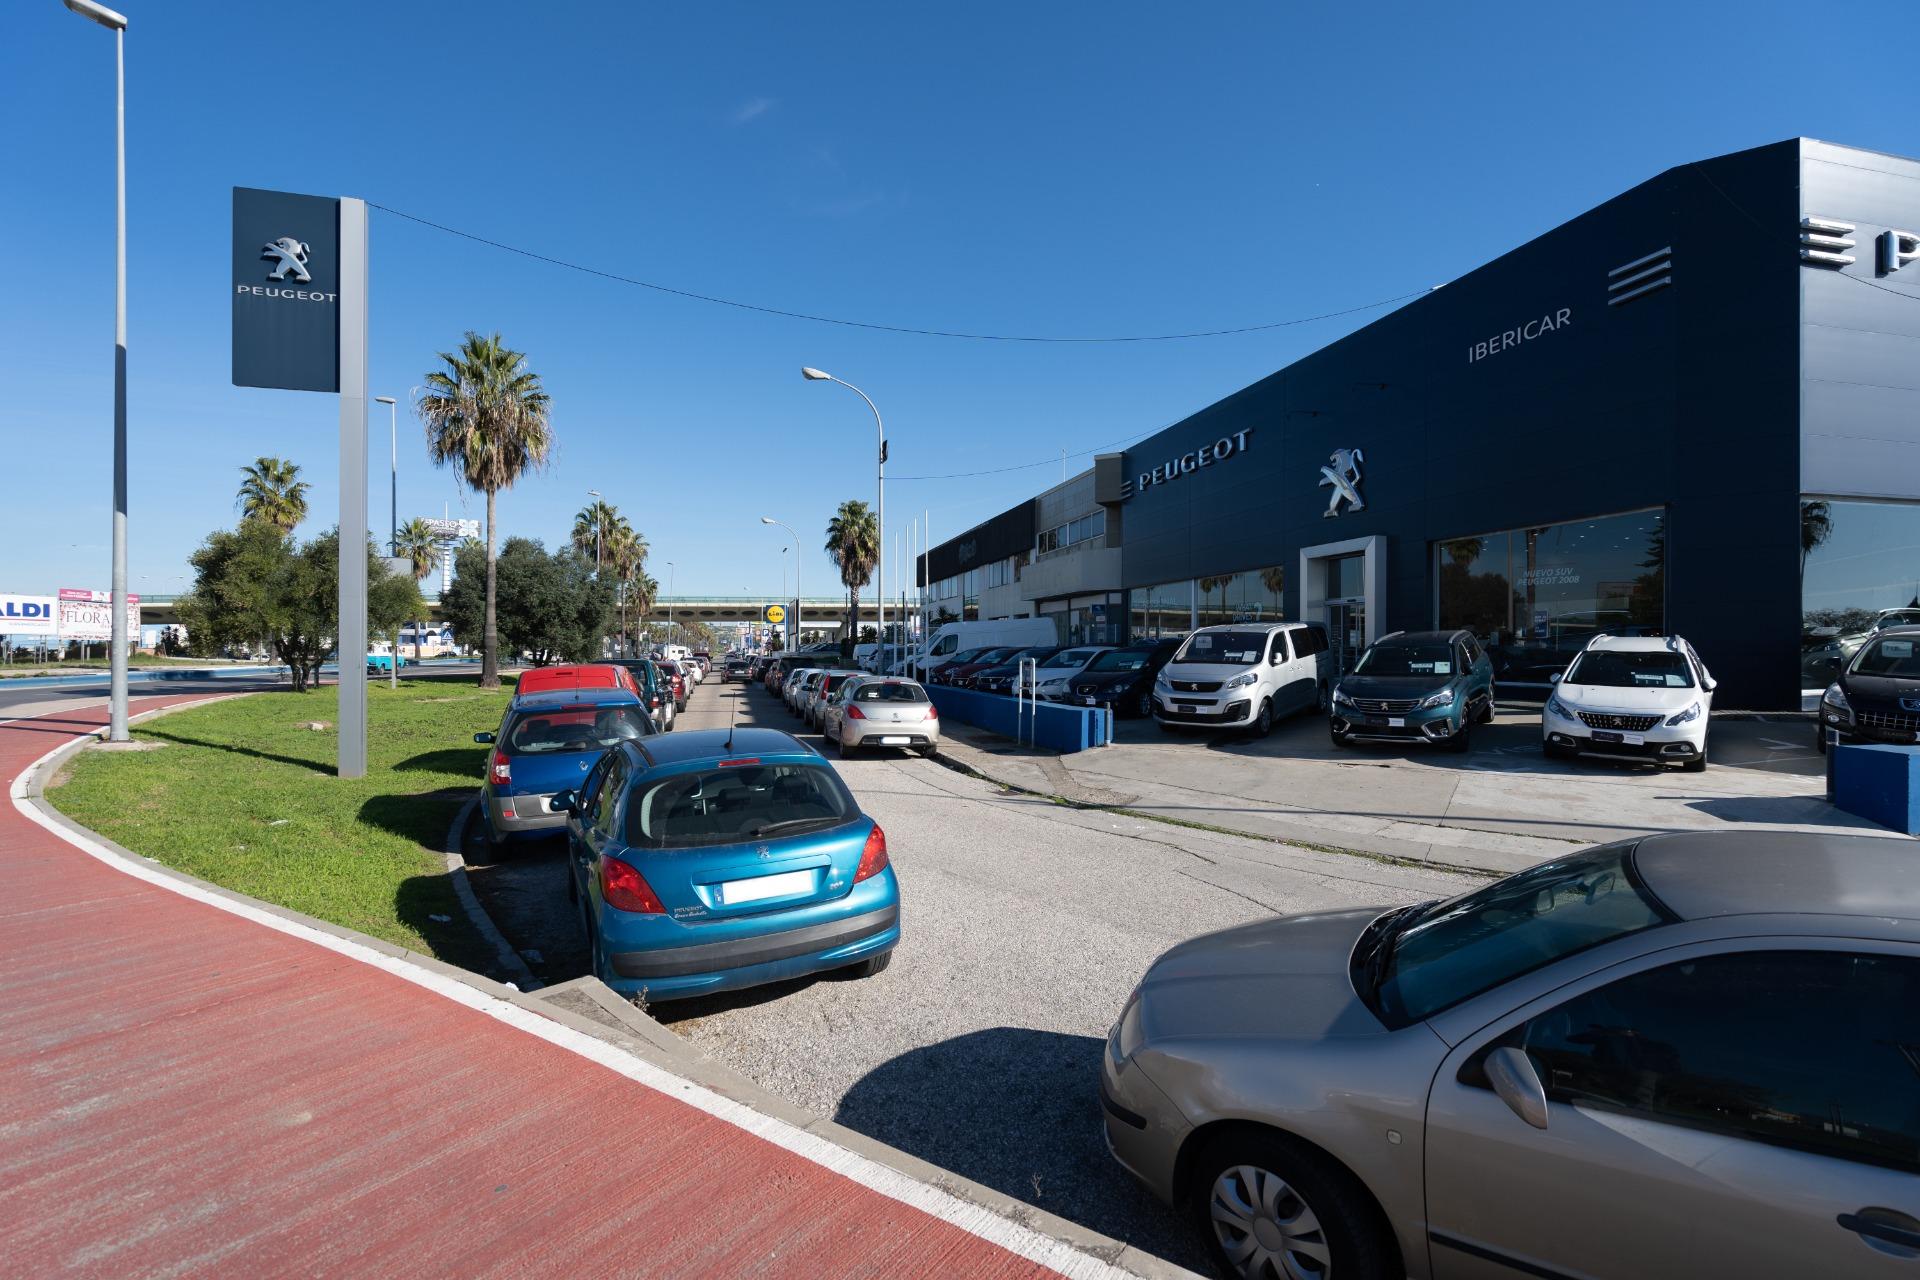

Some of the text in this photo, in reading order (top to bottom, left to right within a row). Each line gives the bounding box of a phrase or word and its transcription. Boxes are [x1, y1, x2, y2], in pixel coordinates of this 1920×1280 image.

[236, 285, 337, 303] PEUGEOT
[1469, 307, 1571, 364] IBERICAR
[1139, 428, 1252, 491] PEUGEOT
[1516, 576, 1580, 586] PEUGEOT 2008
[1523, 567, 1574, 578] NUEVO SUV
